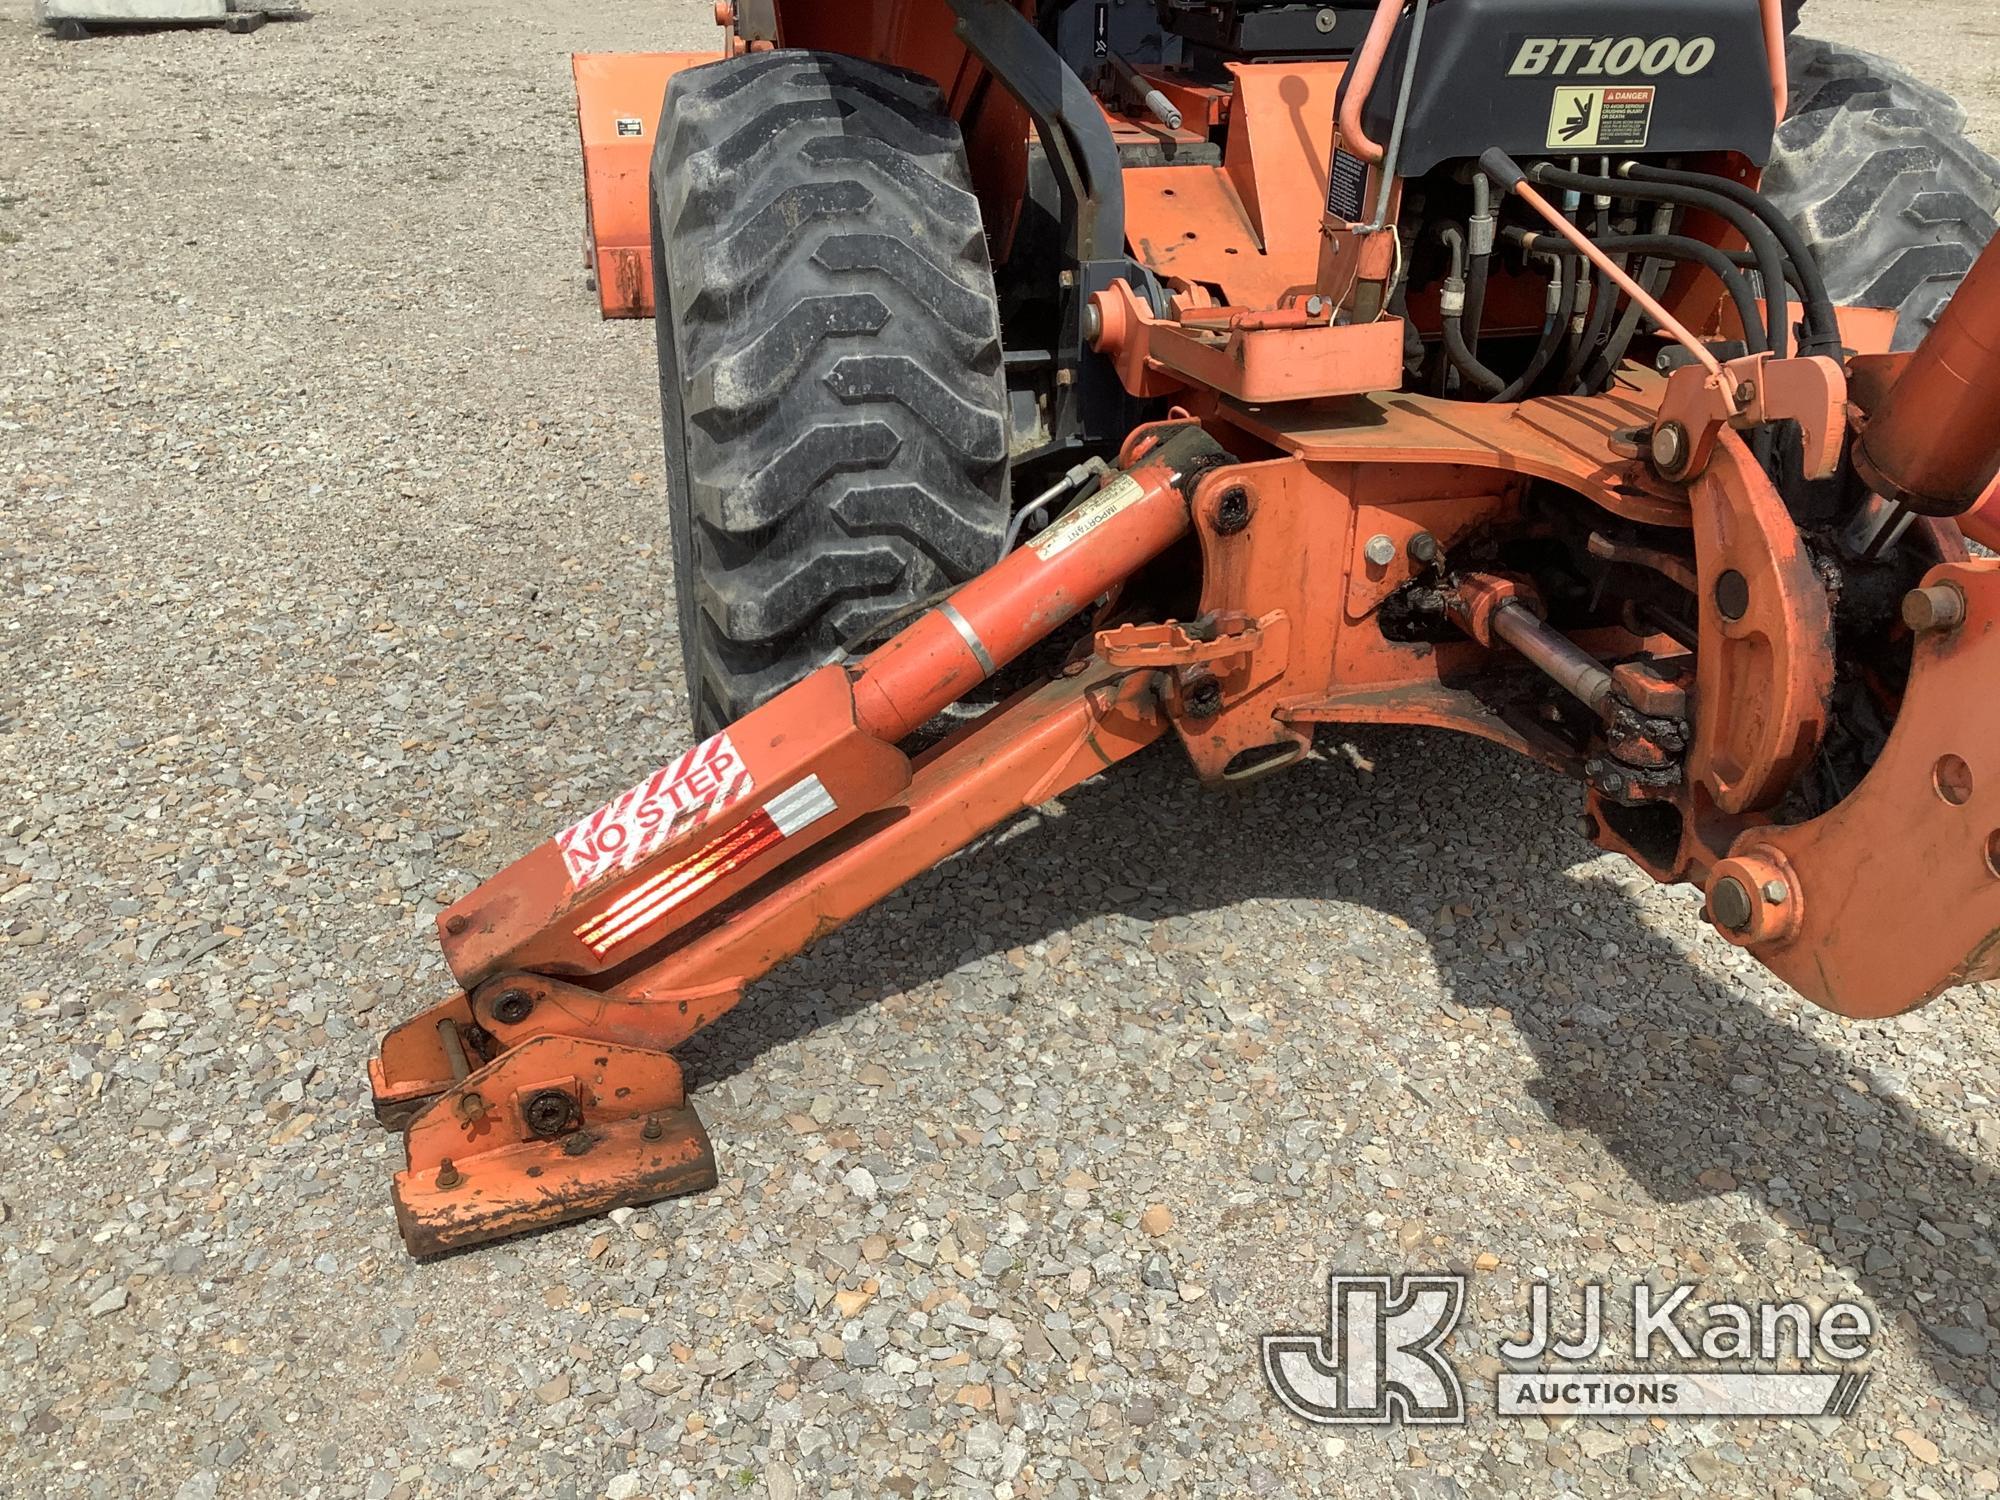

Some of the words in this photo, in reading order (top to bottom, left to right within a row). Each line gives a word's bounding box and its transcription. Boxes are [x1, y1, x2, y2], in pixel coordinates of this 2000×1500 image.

[1507, 36, 1716, 76] BT1000
[1615, 91, 1649, 100] DANGER
[1068, 504, 1118, 542] IMPORTANT
[567, 821, 626, 874] NO
[635, 752, 736, 830] STEP
